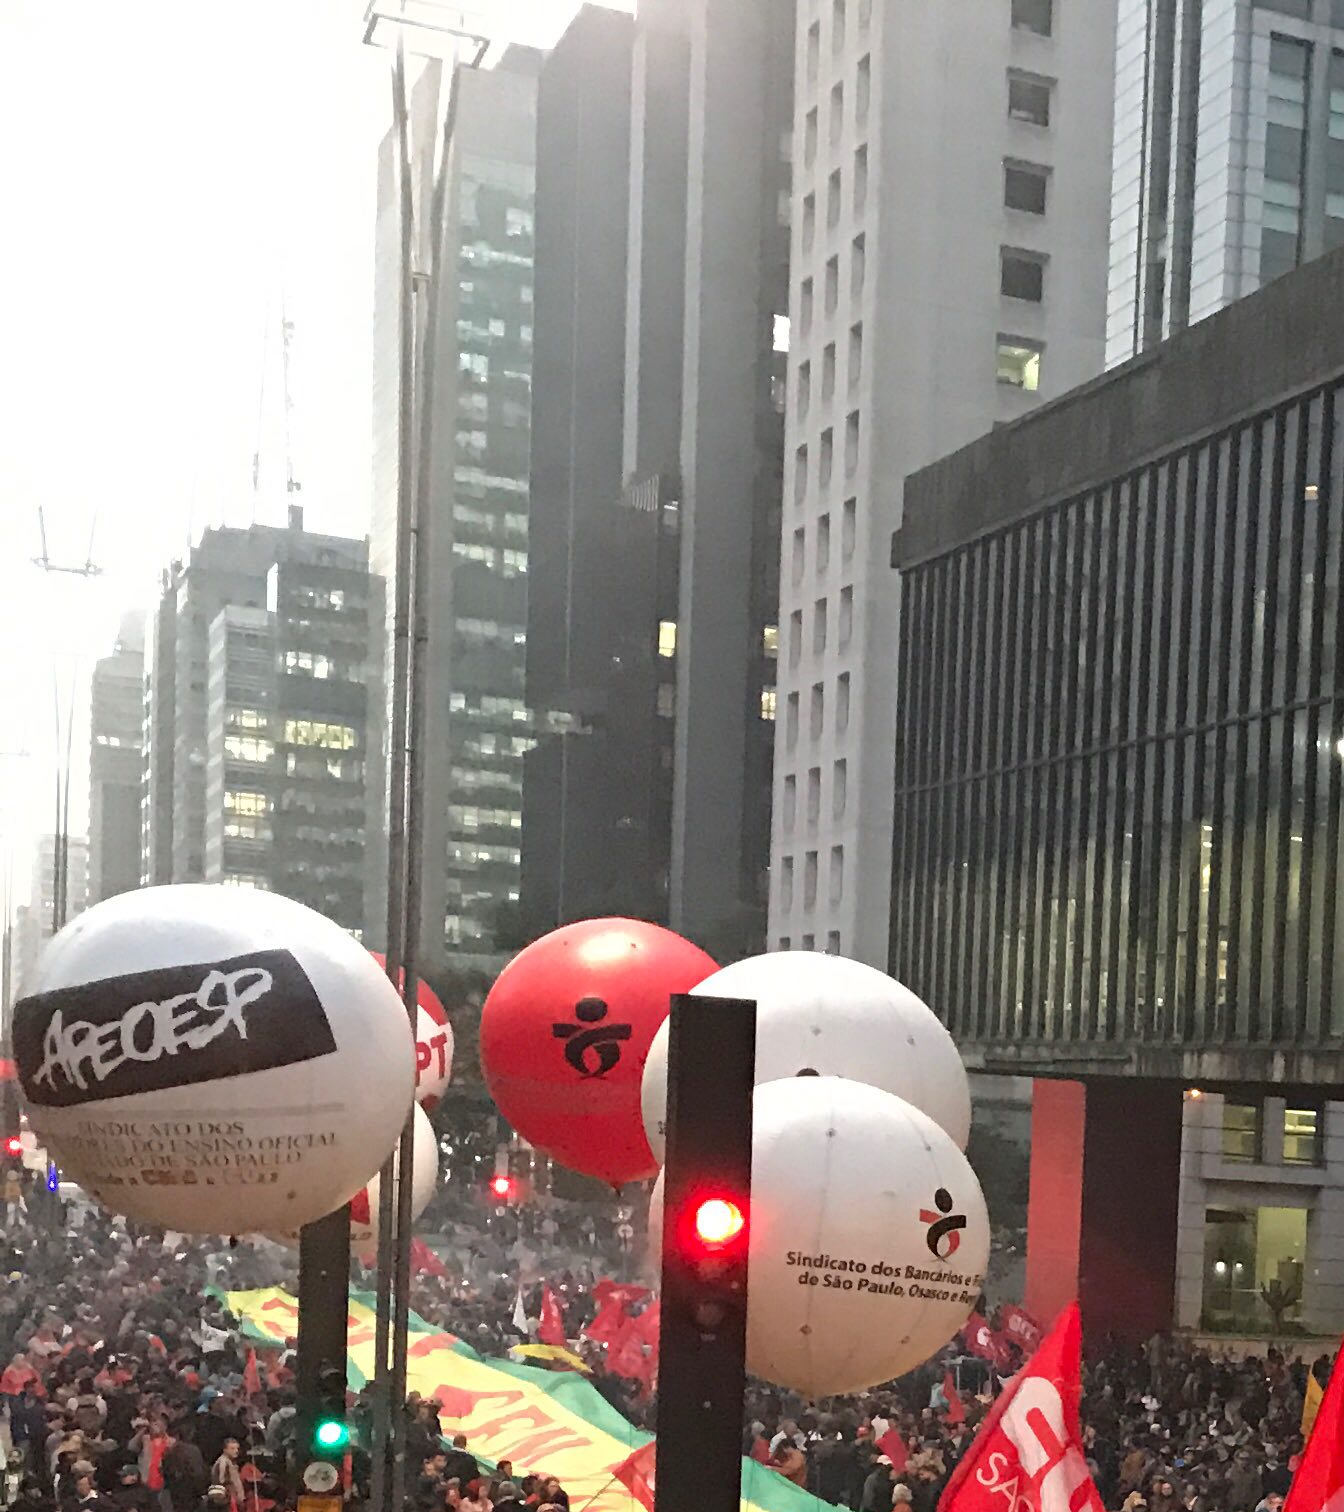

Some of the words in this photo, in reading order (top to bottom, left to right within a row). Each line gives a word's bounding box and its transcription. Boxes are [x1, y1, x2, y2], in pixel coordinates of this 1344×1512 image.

[786, 1251, 867, 1274] Sindicato
[871, 1261, 901, 1278] dos
[905, 1265, 963, 1287] Bancários
[798, 1272, 819, 1286] de
[822, 1273, 853, 1291] São
[857, 1278, 905, 1298] Paulo,
[908, 1284, 949, 1302] Osasco
